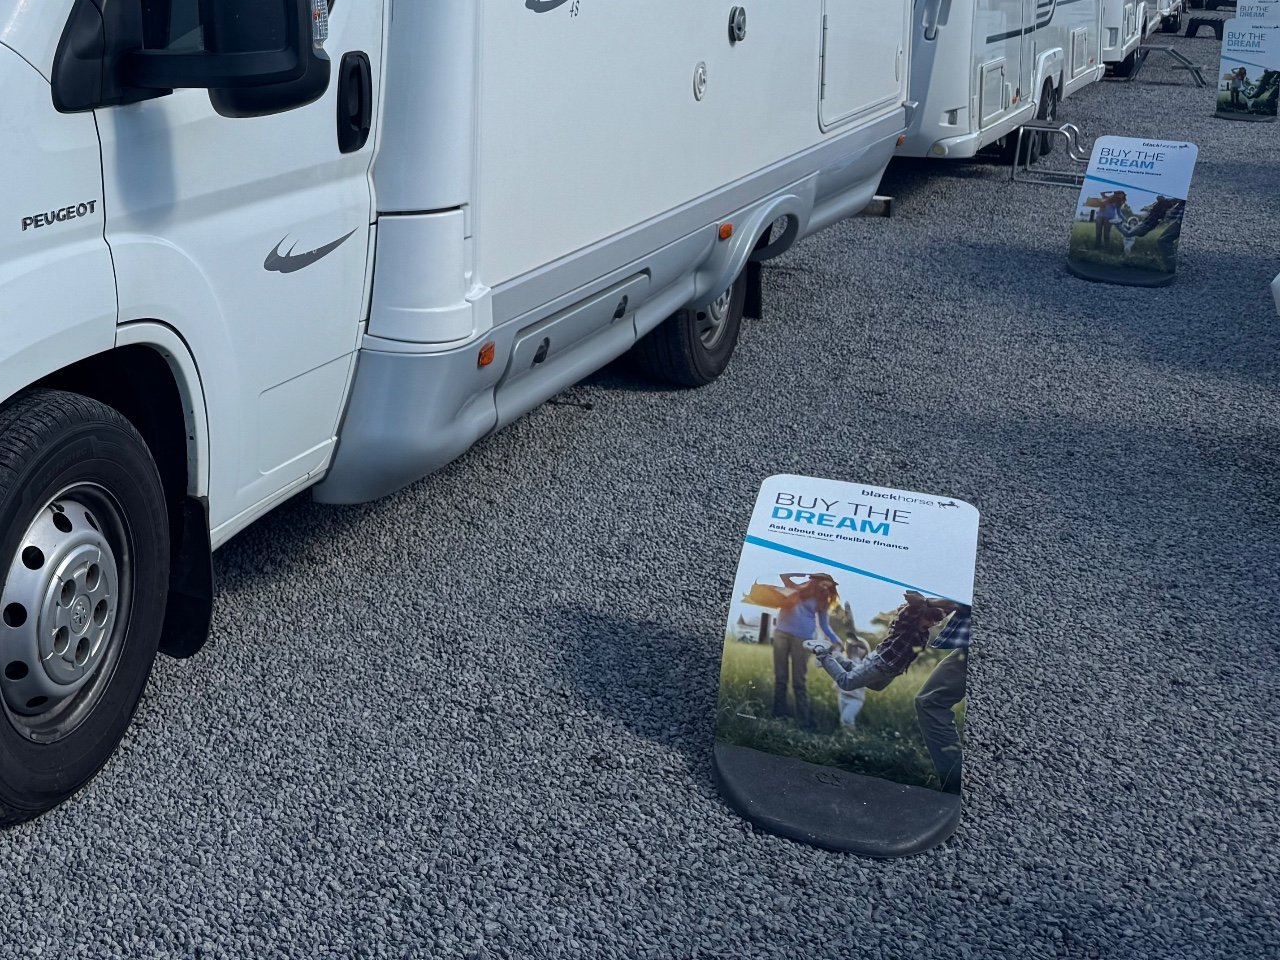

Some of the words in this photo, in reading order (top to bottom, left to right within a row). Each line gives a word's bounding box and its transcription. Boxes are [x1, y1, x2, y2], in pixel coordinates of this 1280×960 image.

[1227, 31, 1247, 40] BUY
[1248, 32, 1267, 41] THE
[1227, 39, 1261, 48] DREAM
[1098, 156, 1155, 170] DREAM
[1100, 147, 1132, 158] BUY
[1135, 150, 1166, 162] THE
[21, 200, 97, 231] PEUGEOT
[861, 489, 935, 506] blackhorse
[775, 492, 839, 512] BUY
[848, 502, 912, 525] THE
[771, 506, 891, 537] DREAM
[769, 523, 786, 531] Ask
[788, 526, 816, 536] about
[835, 533, 871, 545] flexible
[873, 540, 909, 551] finance
